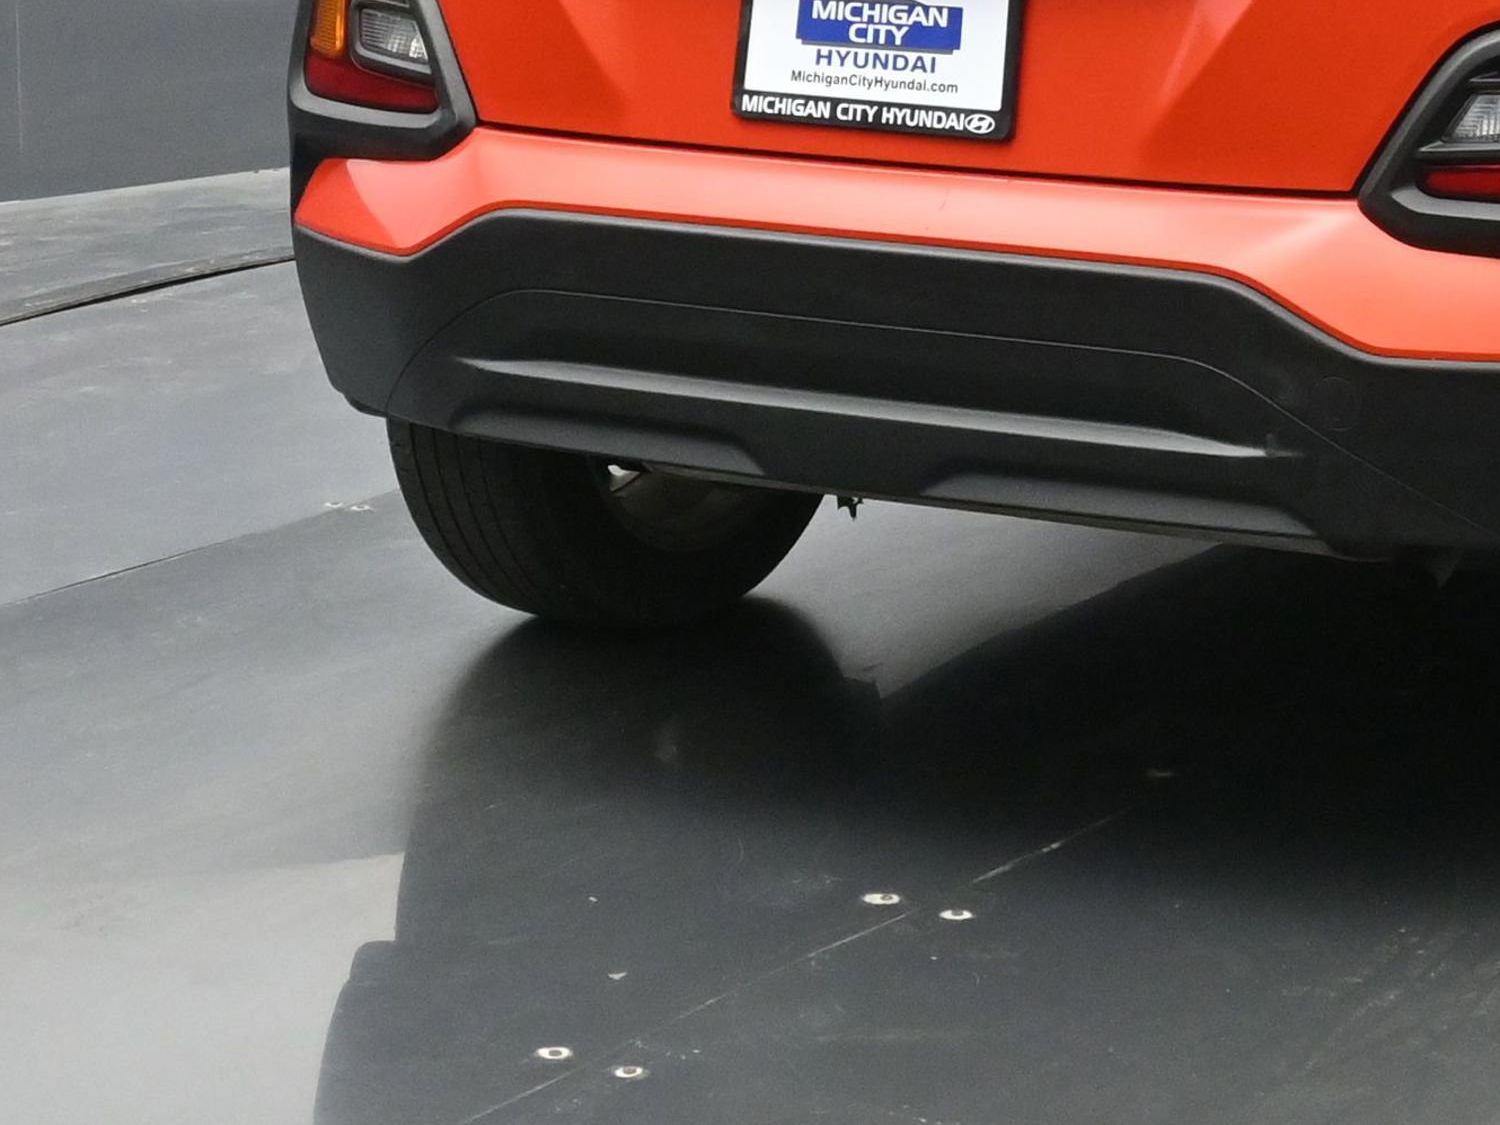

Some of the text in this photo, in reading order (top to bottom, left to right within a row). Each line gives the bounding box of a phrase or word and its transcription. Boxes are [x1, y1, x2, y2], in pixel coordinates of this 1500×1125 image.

[811, 0, 948, 27] MICHIGAN
[848, 23, 909, 45] CITY
[815, 48, 936, 74] HYUNDAI
[790, 70, 958, 94] MichiganCityHyundai.com
[741, 94, 965, 131] MICHIGAN CITY HYUNDAI
